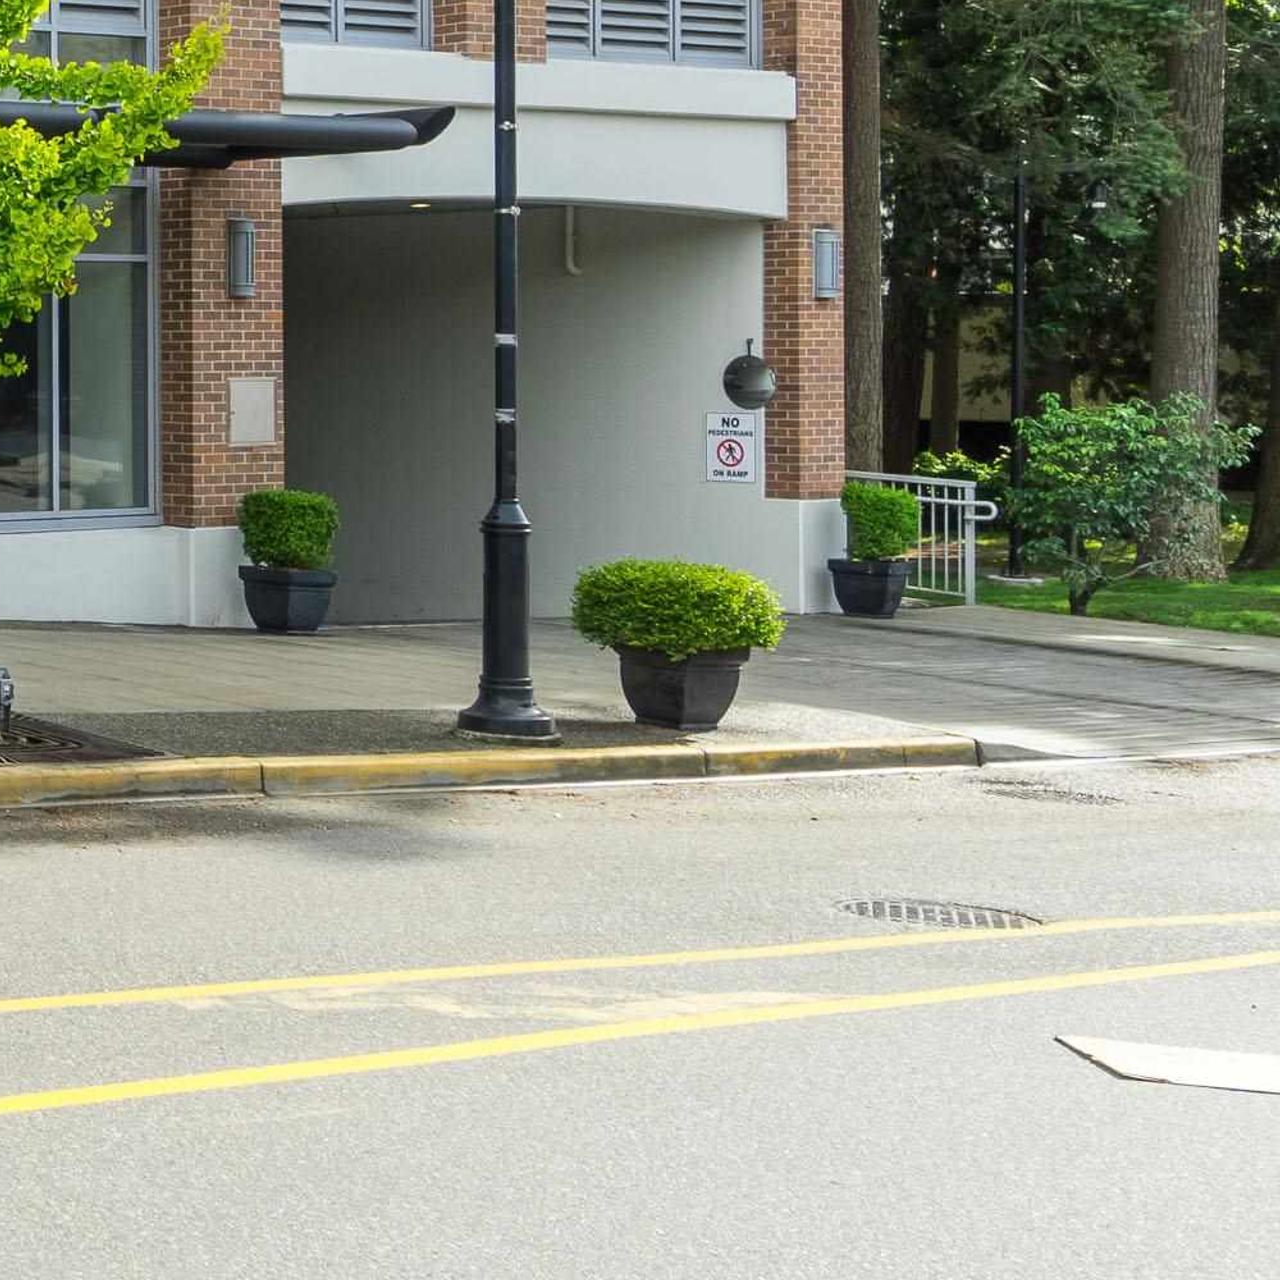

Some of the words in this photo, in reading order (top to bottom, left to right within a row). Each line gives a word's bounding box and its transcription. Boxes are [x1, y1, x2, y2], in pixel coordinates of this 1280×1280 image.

[721, 417, 740, 428] NO
[712, 469, 725, 477] ON
[727, 470, 749, 478] RAMP
